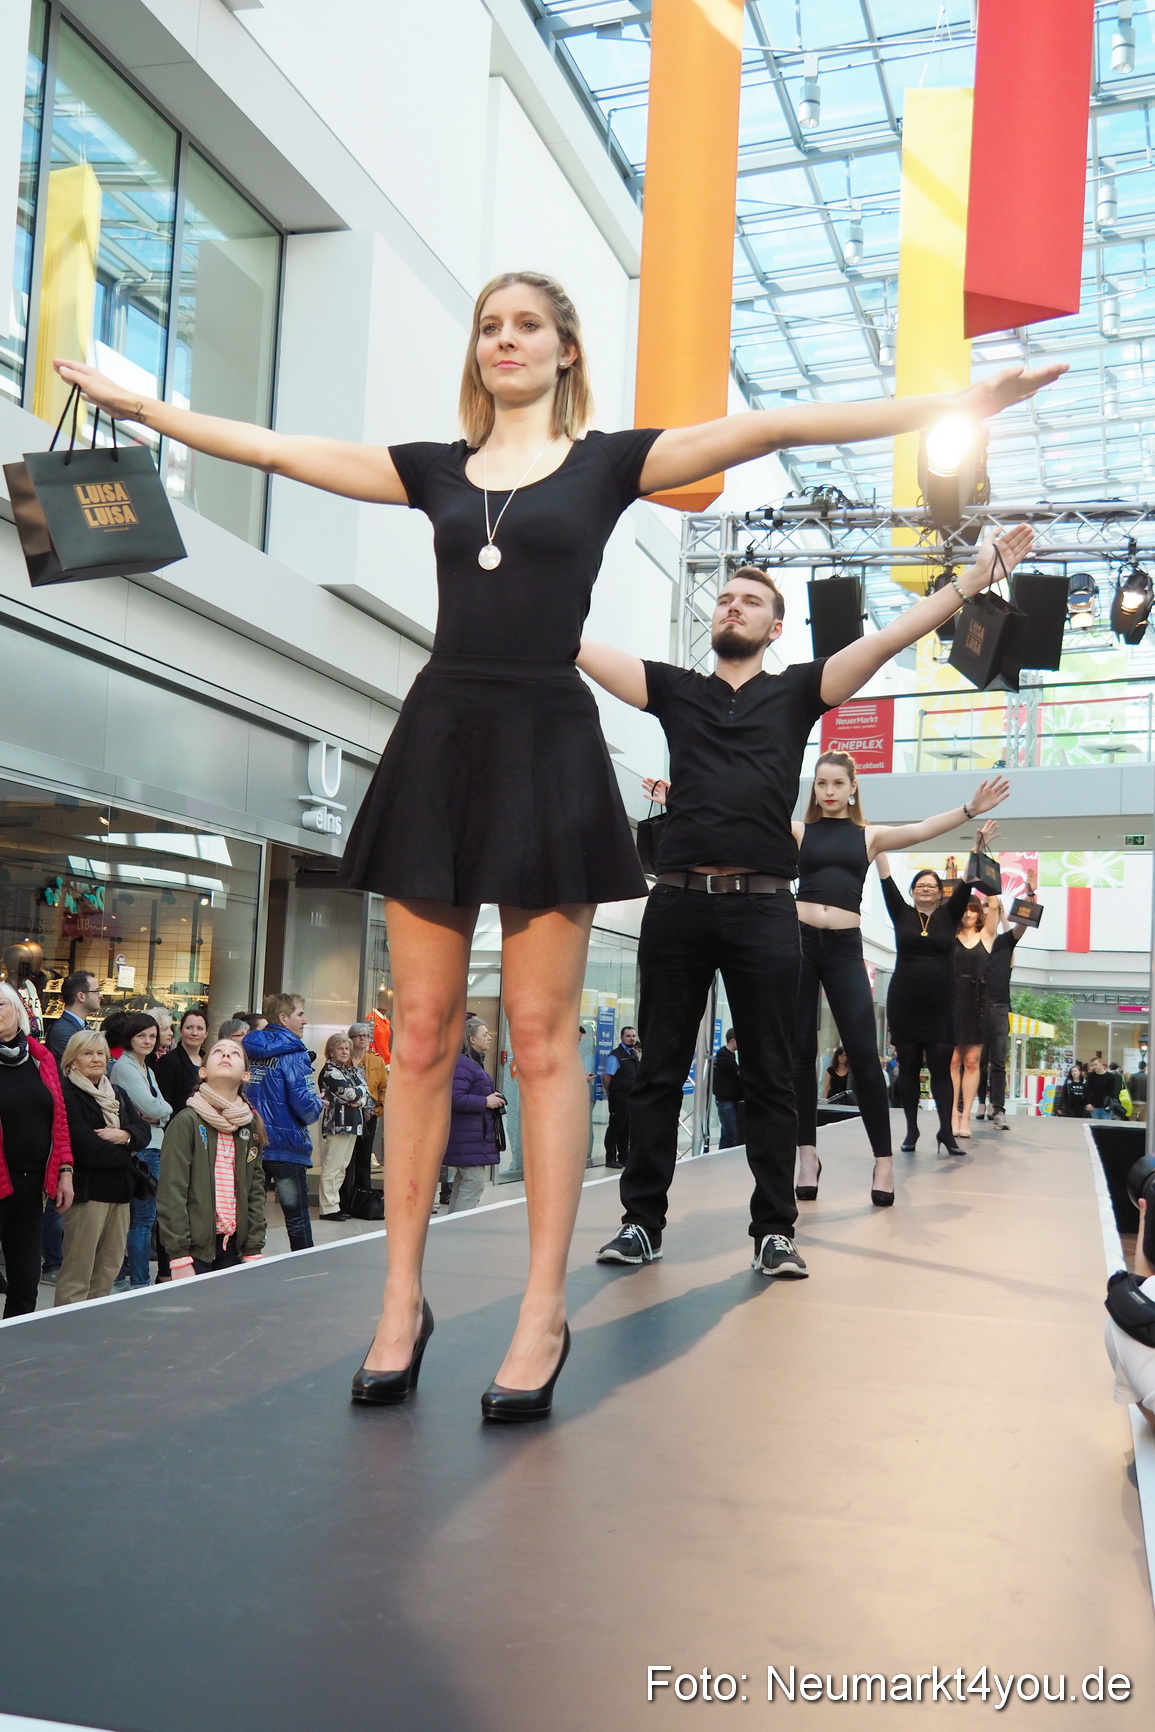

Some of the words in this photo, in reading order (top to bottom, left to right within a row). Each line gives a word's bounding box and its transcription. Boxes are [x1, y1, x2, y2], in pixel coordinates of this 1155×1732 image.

[76, 482, 128, 505] LUISA
[83, 504, 137, 527] LUISA
[835, 716, 878, 725] NeuerMarkt
[828, 738, 884, 751] CINEPLEX
[308, 806, 342, 835] eins
[76, 918, 90, 931] LTB
